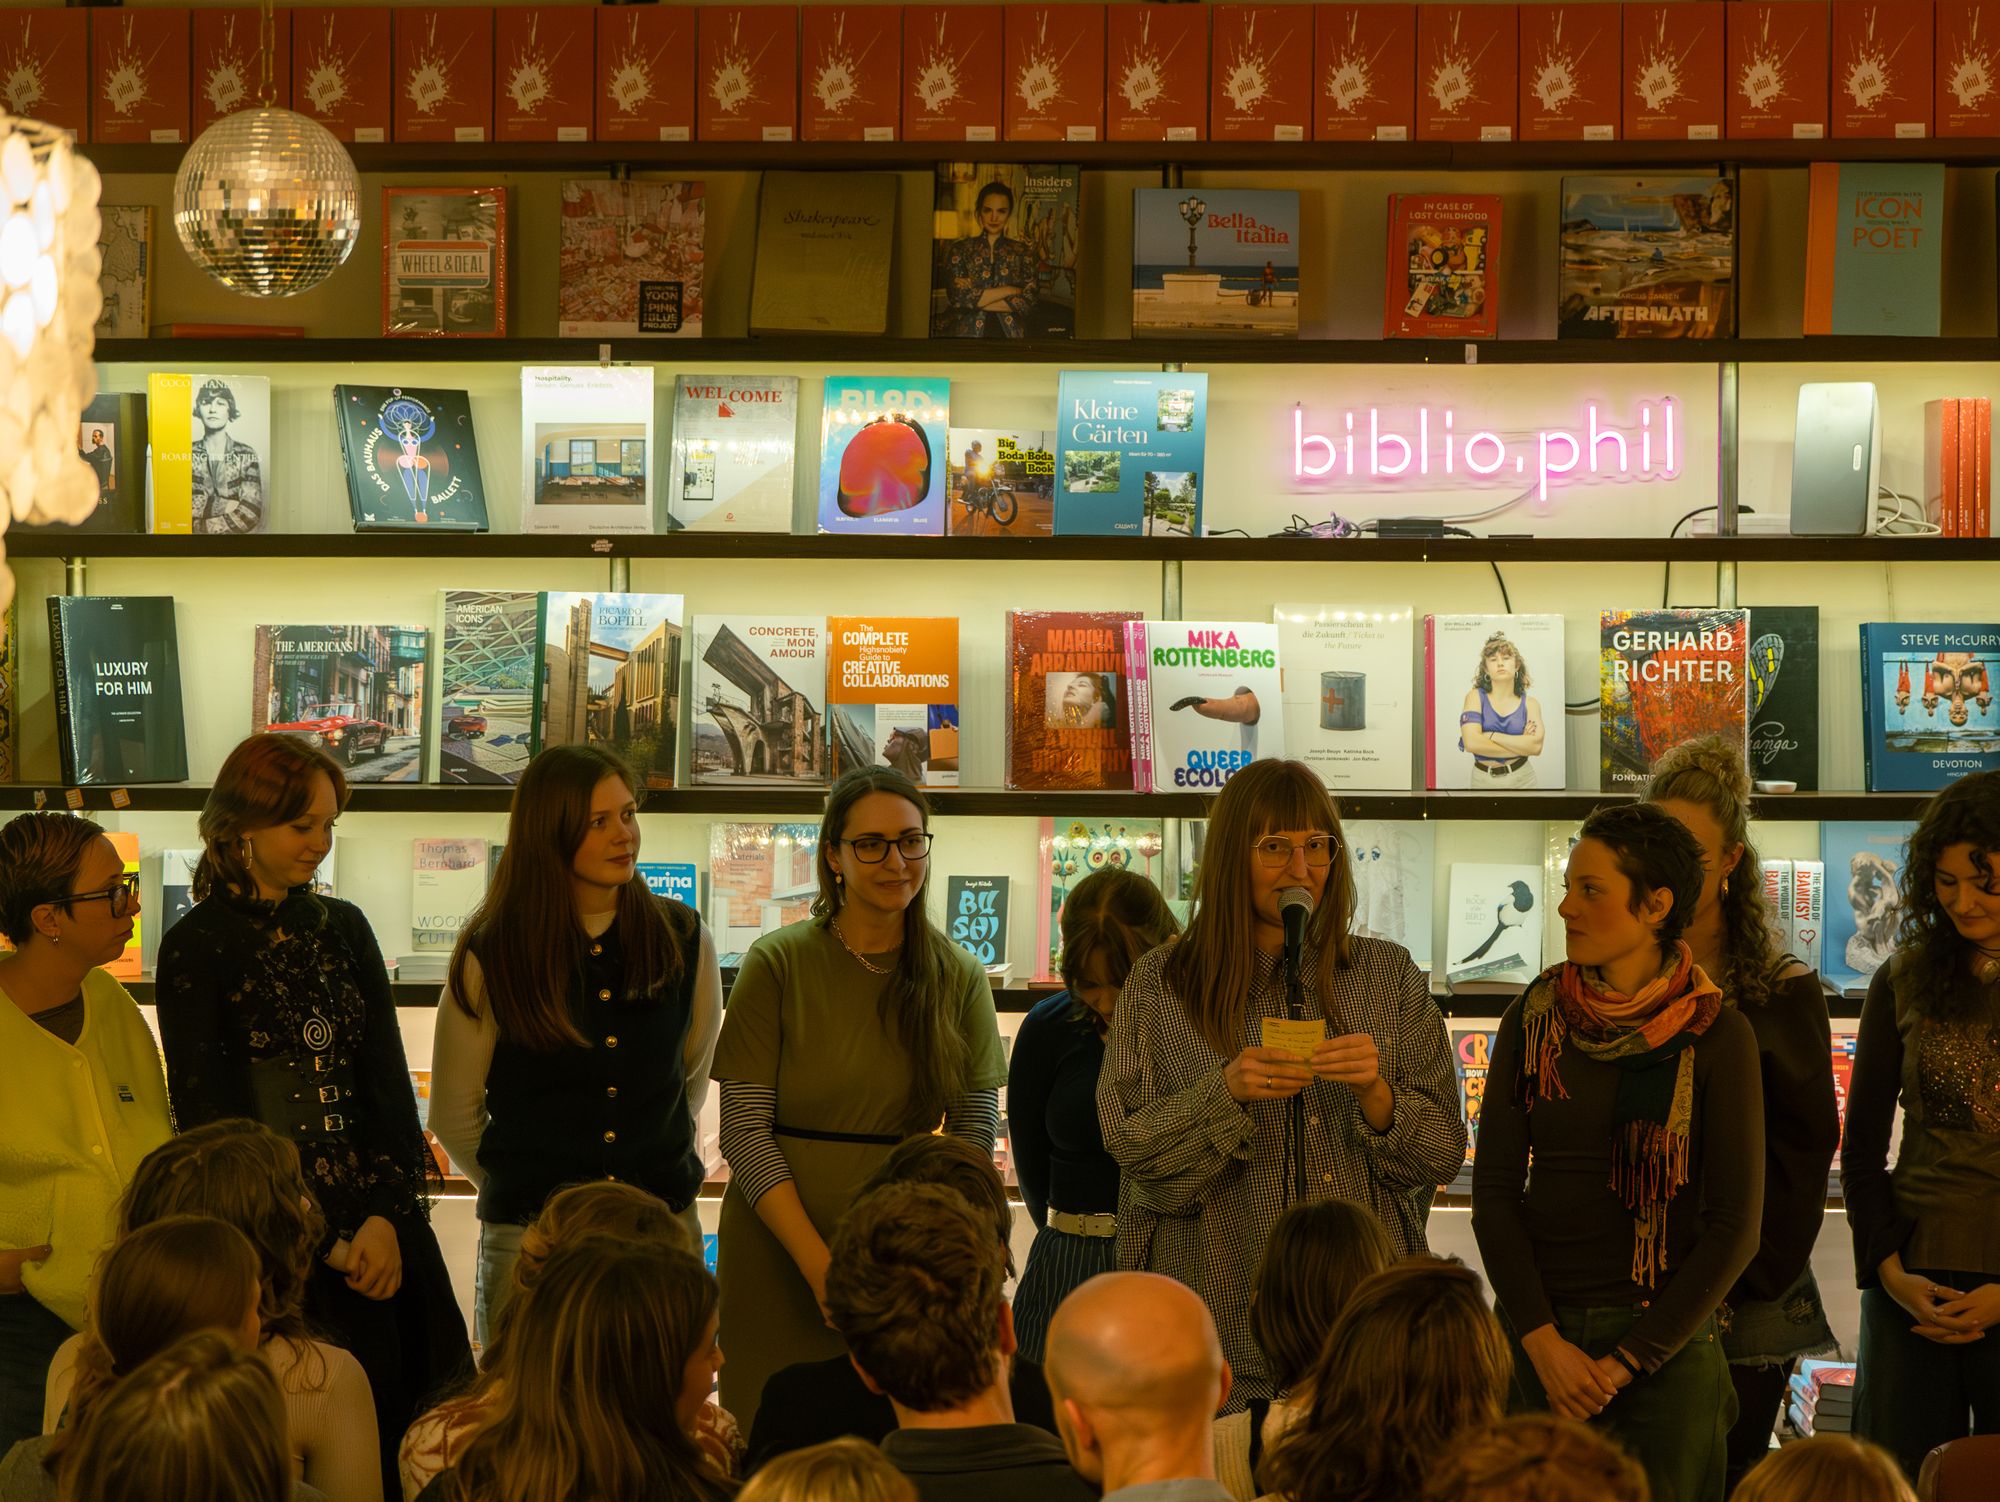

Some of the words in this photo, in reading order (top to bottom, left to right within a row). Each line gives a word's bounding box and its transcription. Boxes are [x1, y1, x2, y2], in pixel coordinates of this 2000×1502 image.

[1025, 175, 1073, 187] Insiders
[1855, 196, 1923, 219] ICON
[784, 210, 881, 228] Shakespeare
[1208, 212, 1258, 229] Bella
[1409, 212, 1433, 220] LOST
[1434, 212, 1489, 220] CHILDHOOD
[1236, 224, 1290, 244] Italia
[1853, 226, 1923, 249] POET
[645, 291, 678, 300] YOON
[1583, 306, 1709, 321] AFTERMATH
[160, 378, 191, 390] COCO
[1073, 398, 1139, 421] Kleine
[1072, 421, 1149, 445] Gärten
[363, 427, 384, 473] BAUHAUS
[998, 438, 1016, 450] Big
[161, 451, 208, 462] ROARING
[998, 451, 1025, 461] Boda
[1027, 452, 1054, 462] Boda
[1027, 464, 1055, 474] Book
[371, 472, 398, 492] DAS
[430, 475, 462, 505] BALLETT
[456, 604, 504, 614] AMERICAN
[599, 606, 643, 616] RICARDO
[456, 614, 484, 624] ICONS
[598, 615, 648, 627] BOFILL
[1365, 620, 1374, 629] in
[52, 606, 63, 659] LUXURY
[749, 626, 819, 639] CONCRETE,
[860, 624, 874, 633] The
[1302, 630, 1315, 639] die
[1315, 630, 1347, 640] Zukunft
[787, 638, 816, 648] MON
[842, 631, 909, 647] COMPLETE
[1047, 628, 1115, 653] MARINA
[1187, 630, 1240, 650] MIKA
[1324, 641, 1337, 650] the
[1337, 641, 1363, 650] Future
[1612, 631, 1734, 652] GERHARD
[1901, 634, 1941, 647] STEVE
[275, 641, 296, 652] THE
[297, 641, 354, 653] AMERICANS
[770, 648, 816, 659] AMOUR
[859, 646, 908, 656] Highsnobiety
[859, 654, 880, 662] Guide
[882, 654, 891, 662] to
[1152, 647, 1277, 670] ROTTENBERG
[57, 661, 67, 688] FOR
[96, 661, 149, 677] LUXURY
[842, 661, 902, 676] CREATIVE
[1612, 659, 1735, 683] RICHTER
[96, 683, 124, 696] FOR
[127, 681, 153, 695] HIM
[842, 674, 950, 689] COLLABORATIONS
[59, 691, 68, 715] HIM
[1126, 679, 1136, 735] ROTTENBERG
[1135, 679, 1144, 735] ROTTENBERG
[1141, 679, 1150, 735] ROTTENBERG
[1932, 760, 1983, 773] DEVOTION
[421, 843, 468, 854] Thomas
[420, 858, 476, 871] Bernhard
[1780, 871, 1790, 885] THE
[1812, 872, 1822, 886] THE
[1780, 886, 1790, 911] WORLD
[1795, 871, 1811, 921] BANKSY
[1811, 887, 1822, 912] WORLD
[1780, 911, 1790, 921] OF
[1811, 912, 1821, 922] OF
